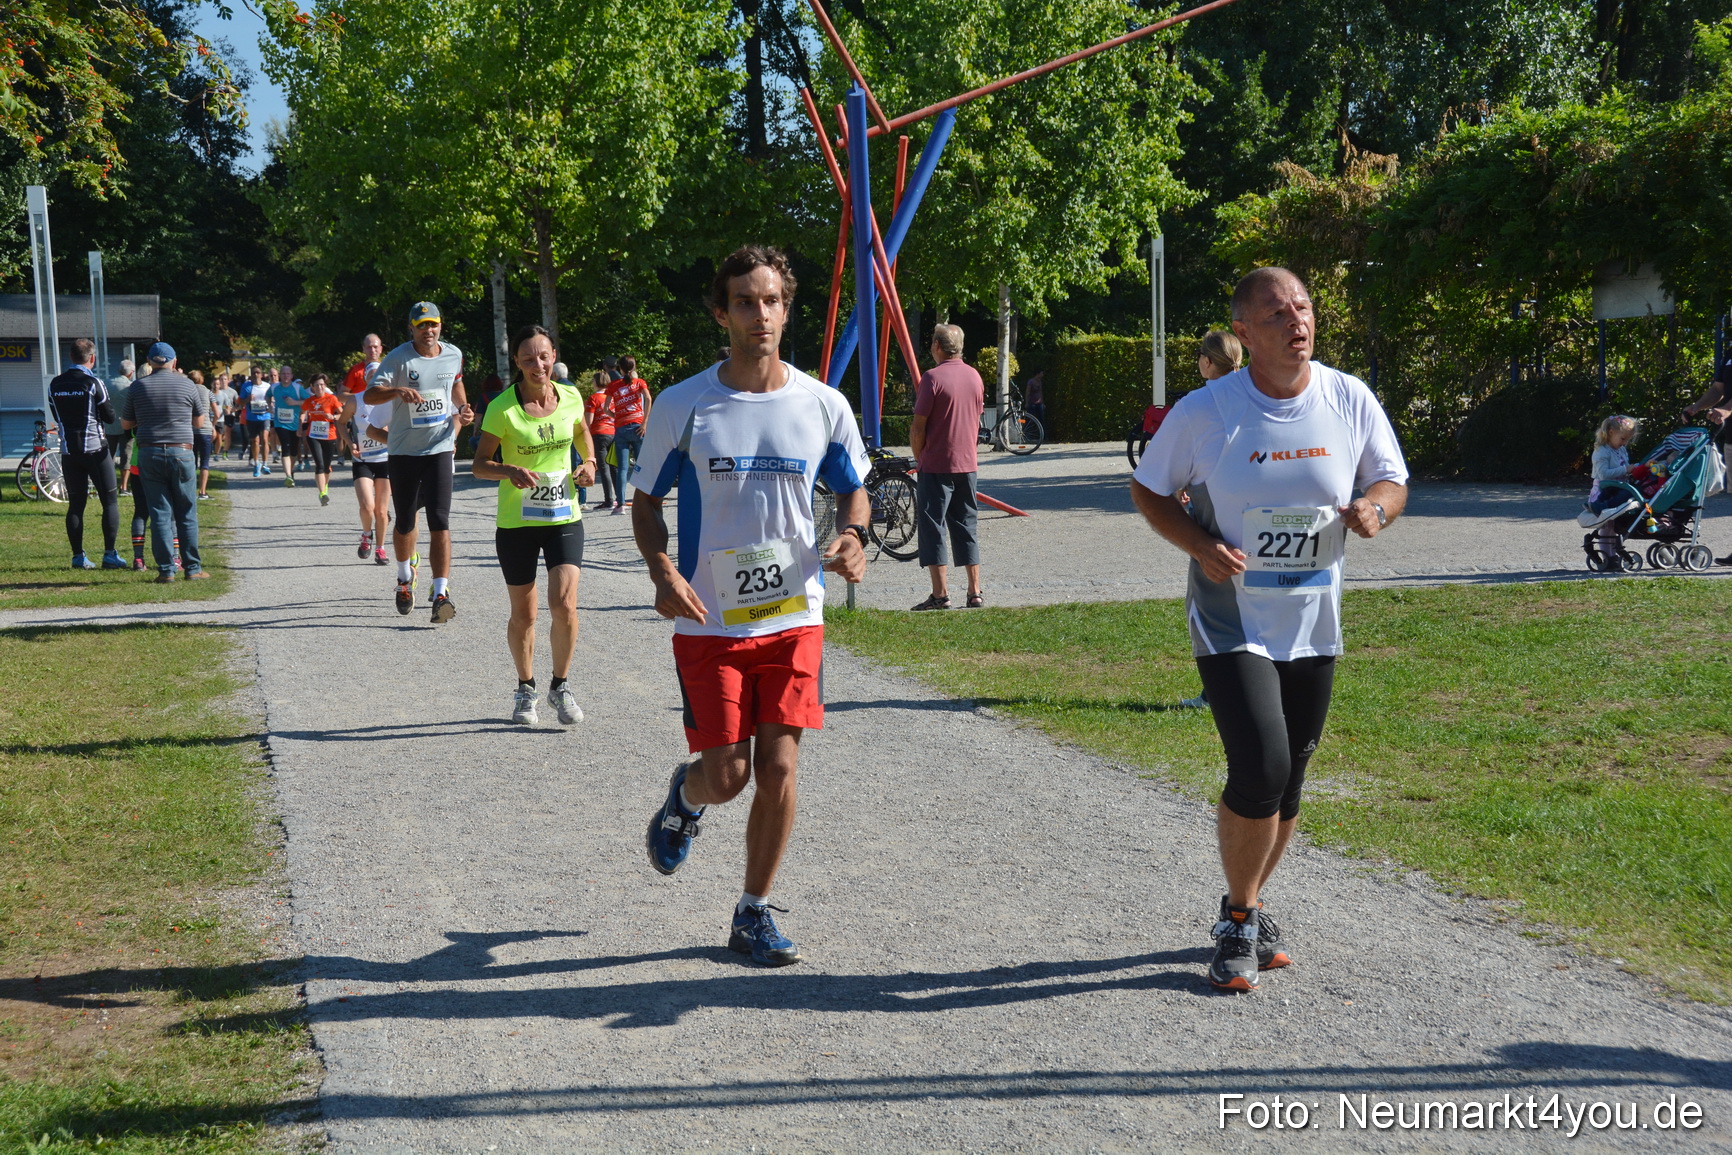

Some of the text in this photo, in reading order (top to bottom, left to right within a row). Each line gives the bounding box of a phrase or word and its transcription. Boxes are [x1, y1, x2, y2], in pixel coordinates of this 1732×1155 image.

[415, 399, 443, 412] 2305
[1271, 448, 1331, 461] KLEBL
[710, 472, 805, 483] FEINSCHNEIDTEAM
[530, 485, 564, 501] 2299
[542, 509, 556, 517] Rita
[1272, 515, 1312, 524] BOCK
[1257, 531, 1320, 558] 2271
[736, 548, 775, 563] BOCK
[735, 563, 784, 595] 233
[1278, 575, 1301, 585] Uwe
[756, 592, 781, 601] Neumarkt
[748, 605, 782, 620] Simon
